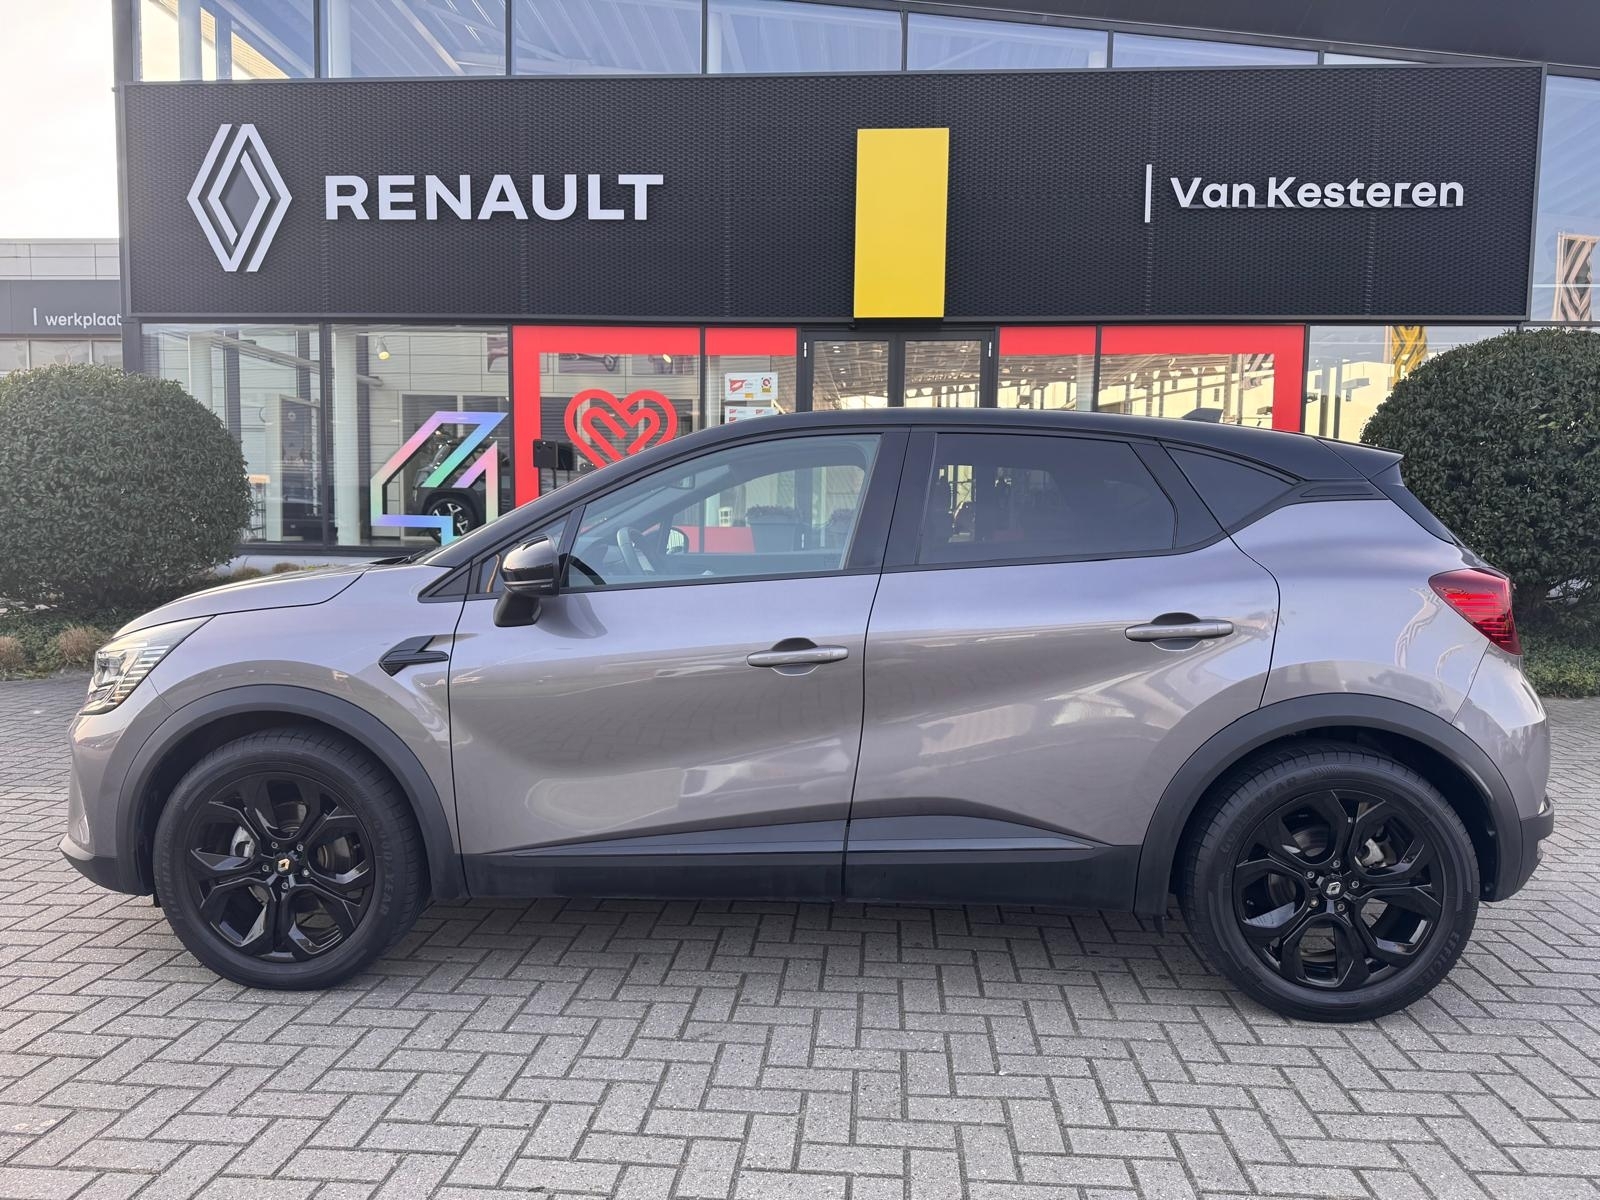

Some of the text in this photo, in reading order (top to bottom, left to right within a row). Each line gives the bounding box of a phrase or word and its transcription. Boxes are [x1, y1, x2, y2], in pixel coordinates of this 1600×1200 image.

[325, 173, 663, 221] RENAULT
[1170, 176, 1464, 208] Van Kesteren
